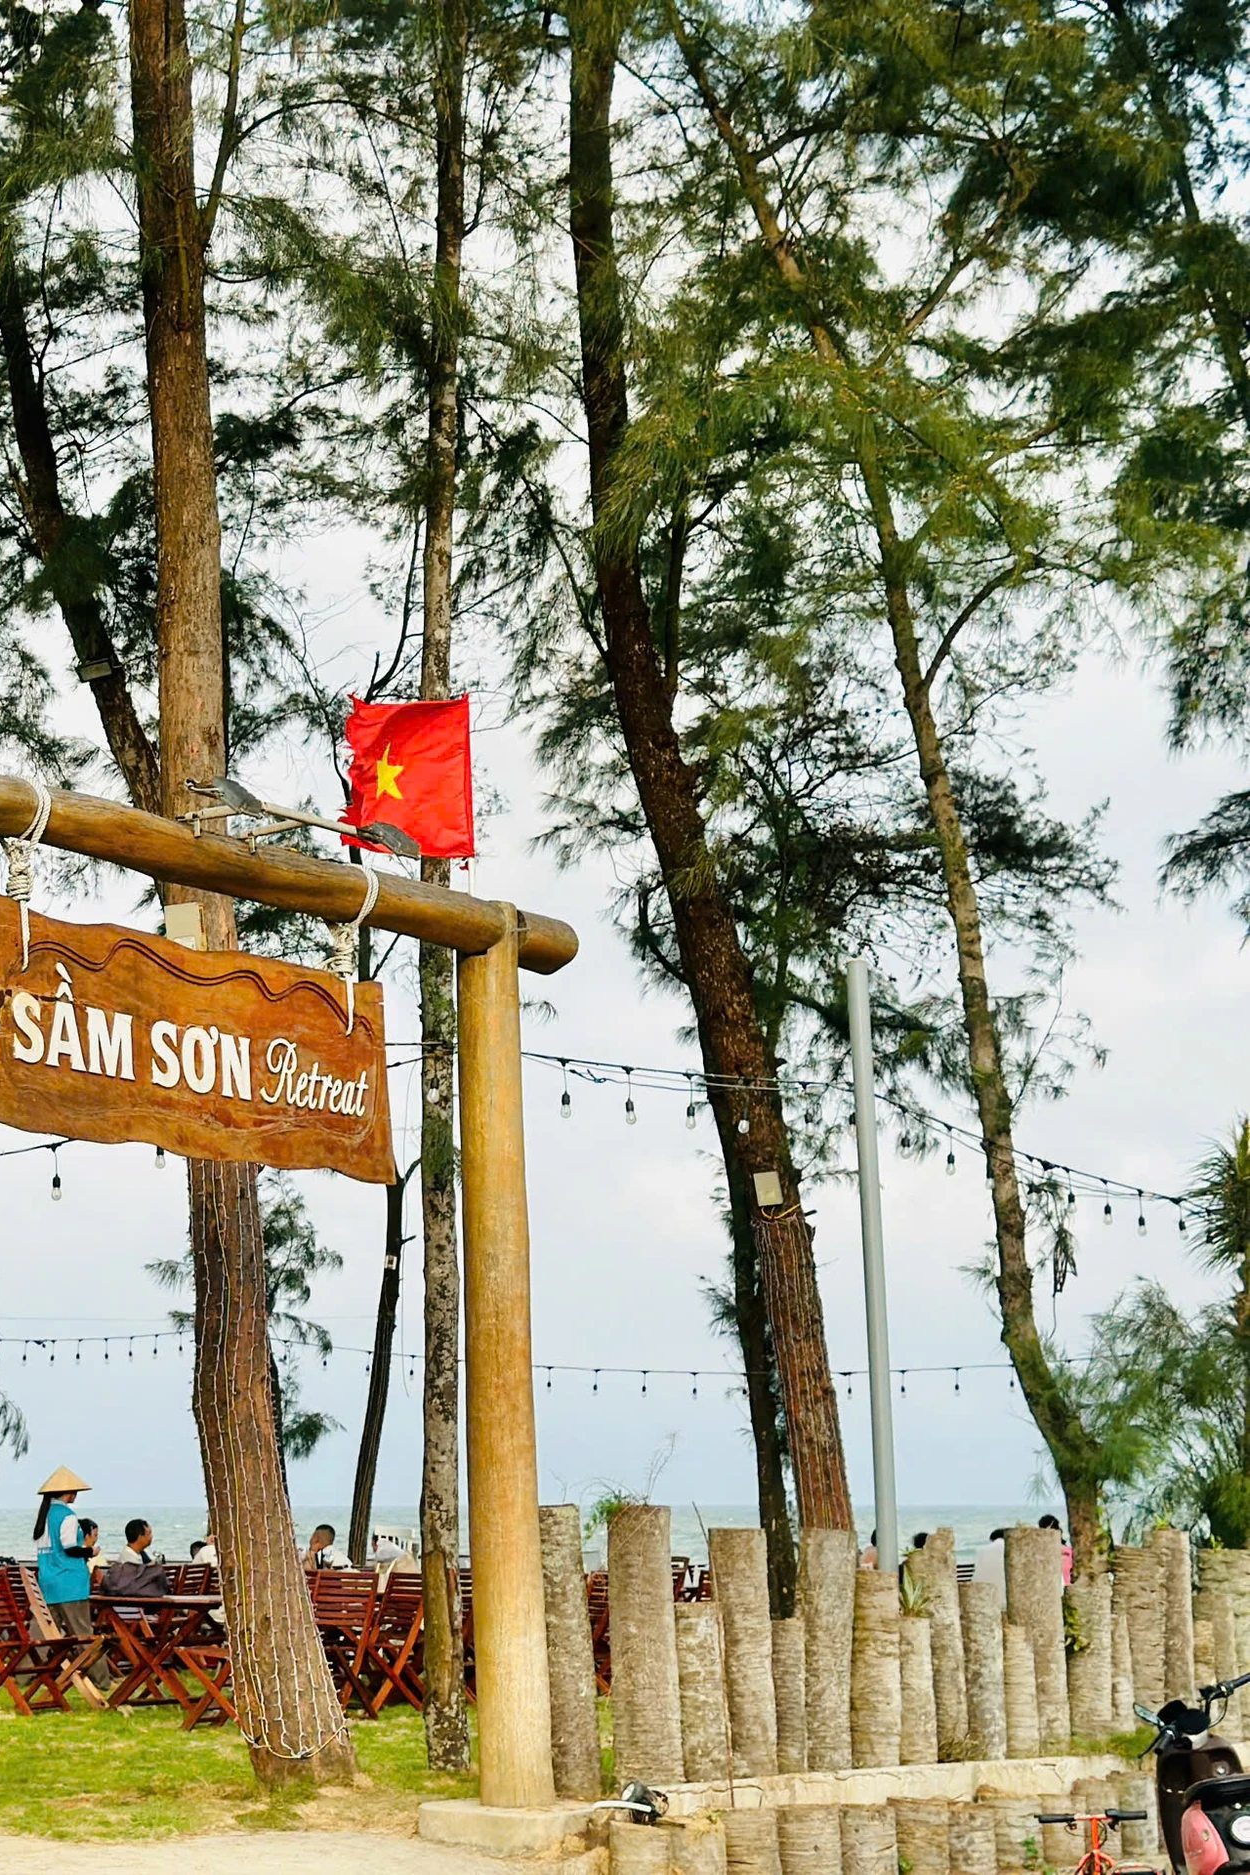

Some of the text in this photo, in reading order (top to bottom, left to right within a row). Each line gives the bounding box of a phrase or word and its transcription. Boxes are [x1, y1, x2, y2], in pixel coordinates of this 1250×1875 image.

[12, 962, 369, 1116] SẦM SƠN Retreat
